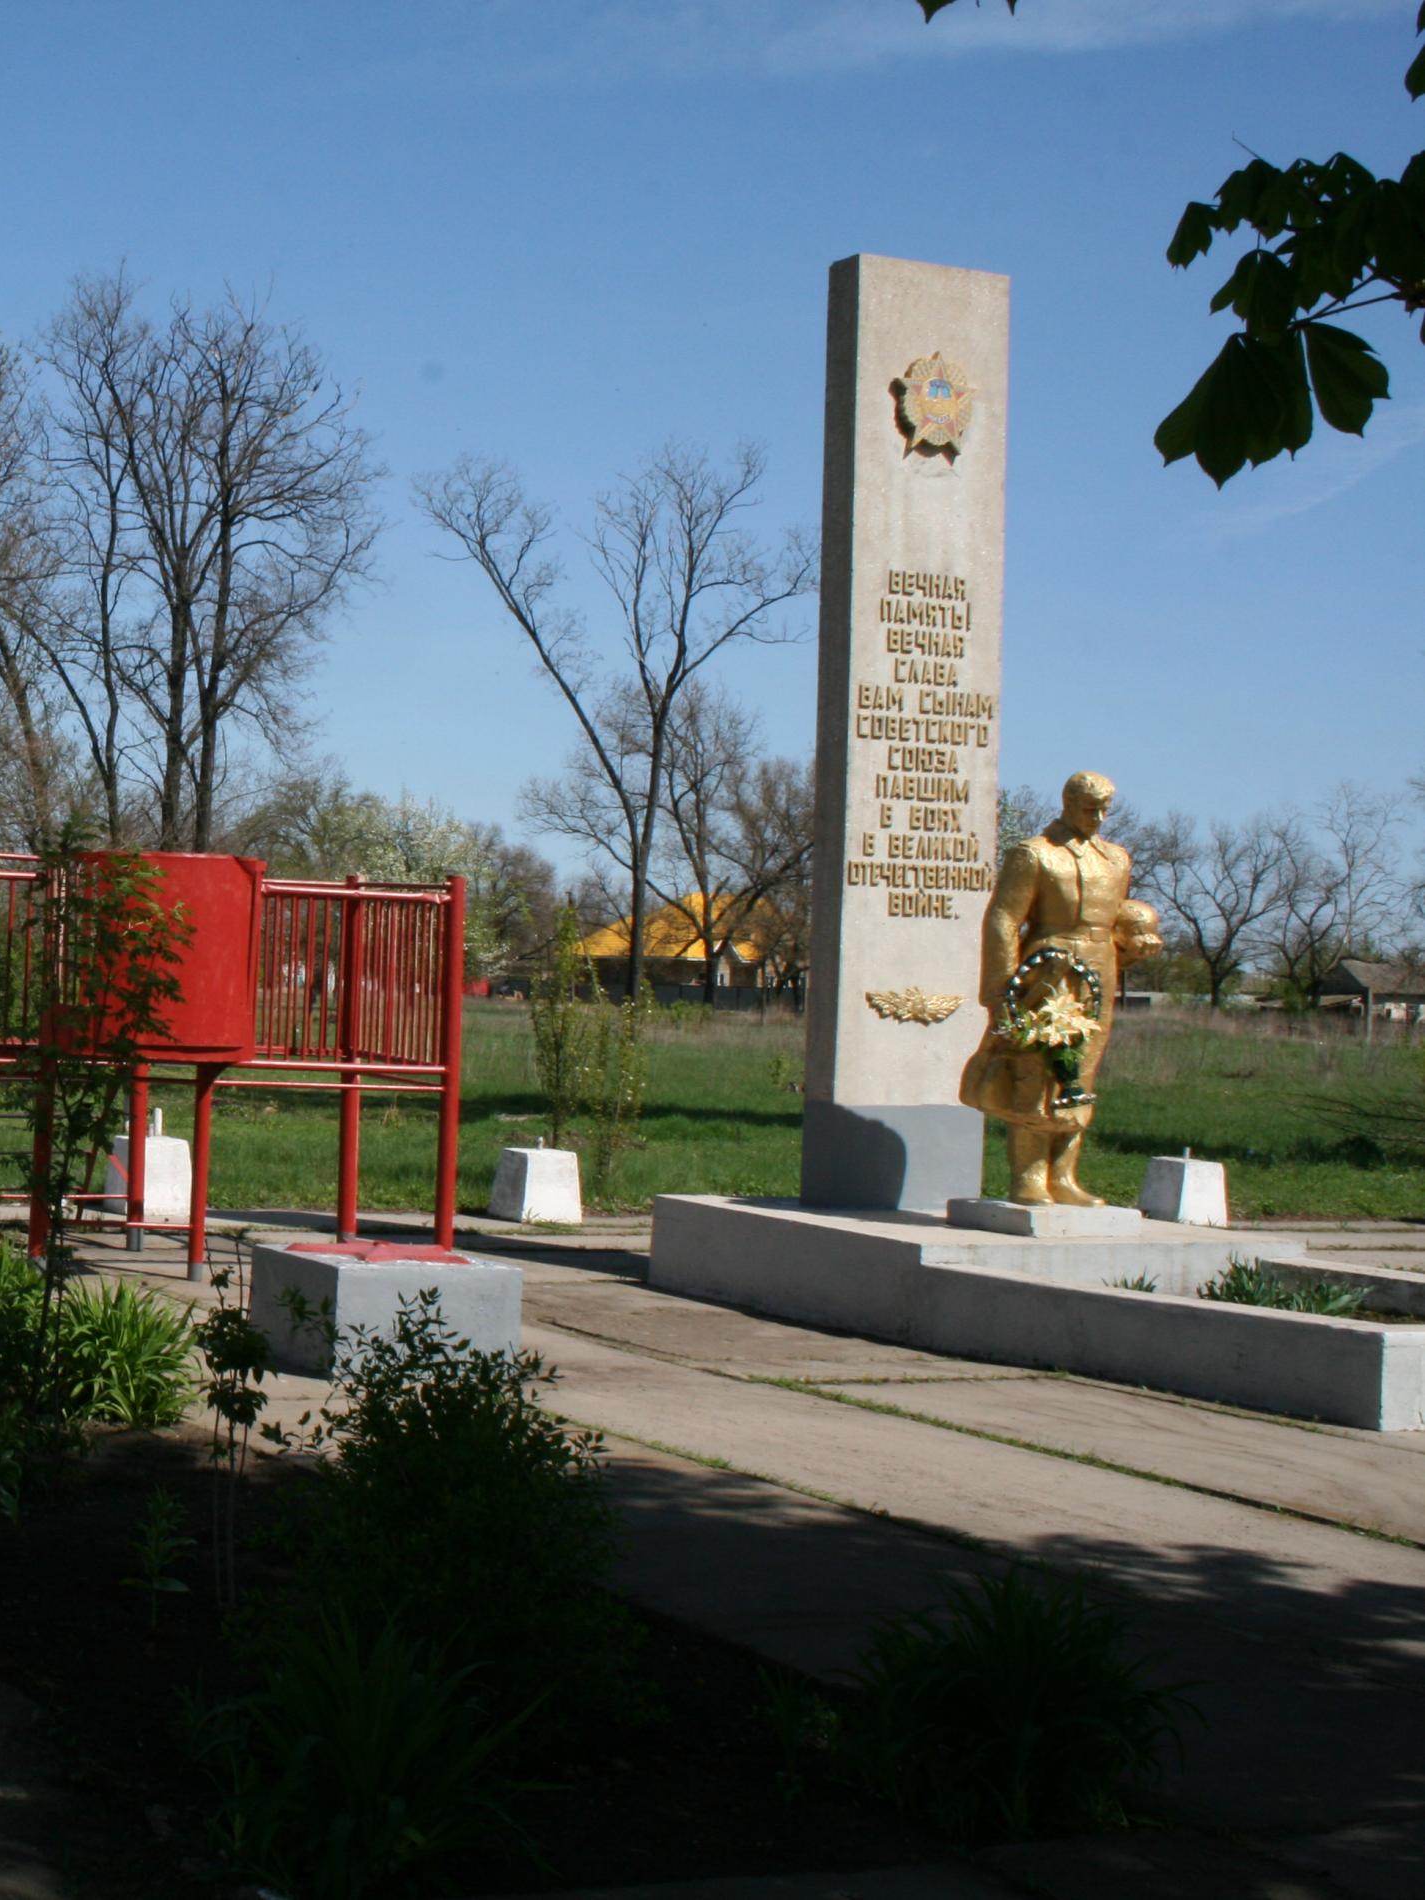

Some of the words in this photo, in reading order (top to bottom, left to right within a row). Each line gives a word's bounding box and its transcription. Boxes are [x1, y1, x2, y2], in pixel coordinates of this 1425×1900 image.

[888, 569, 967, 601] ВЕЧНАЯ
[886, 628, 965, 659] ВЕЧНАЯ
[894, 657, 959, 688] СЛАВА
[858, 683, 904, 713] ВАМ
[919, 689, 994, 720] СЫНАМ
[856, 714, 990, 748] СОВЕТСКОГО
[887, 745, 960, 774] СОЮЗА
[875, 773, 970, 804] ПАВШИМ
[879, 803, 893, 829] В
[909, 805, 963, 833] БОЯХ
[862, 832, 876, 857] В
[888, 832, 982, 862] ВЕЛИКОЙ
[847, 860, 996, 893] ОТЕЧЕСТВЕННОЙ
